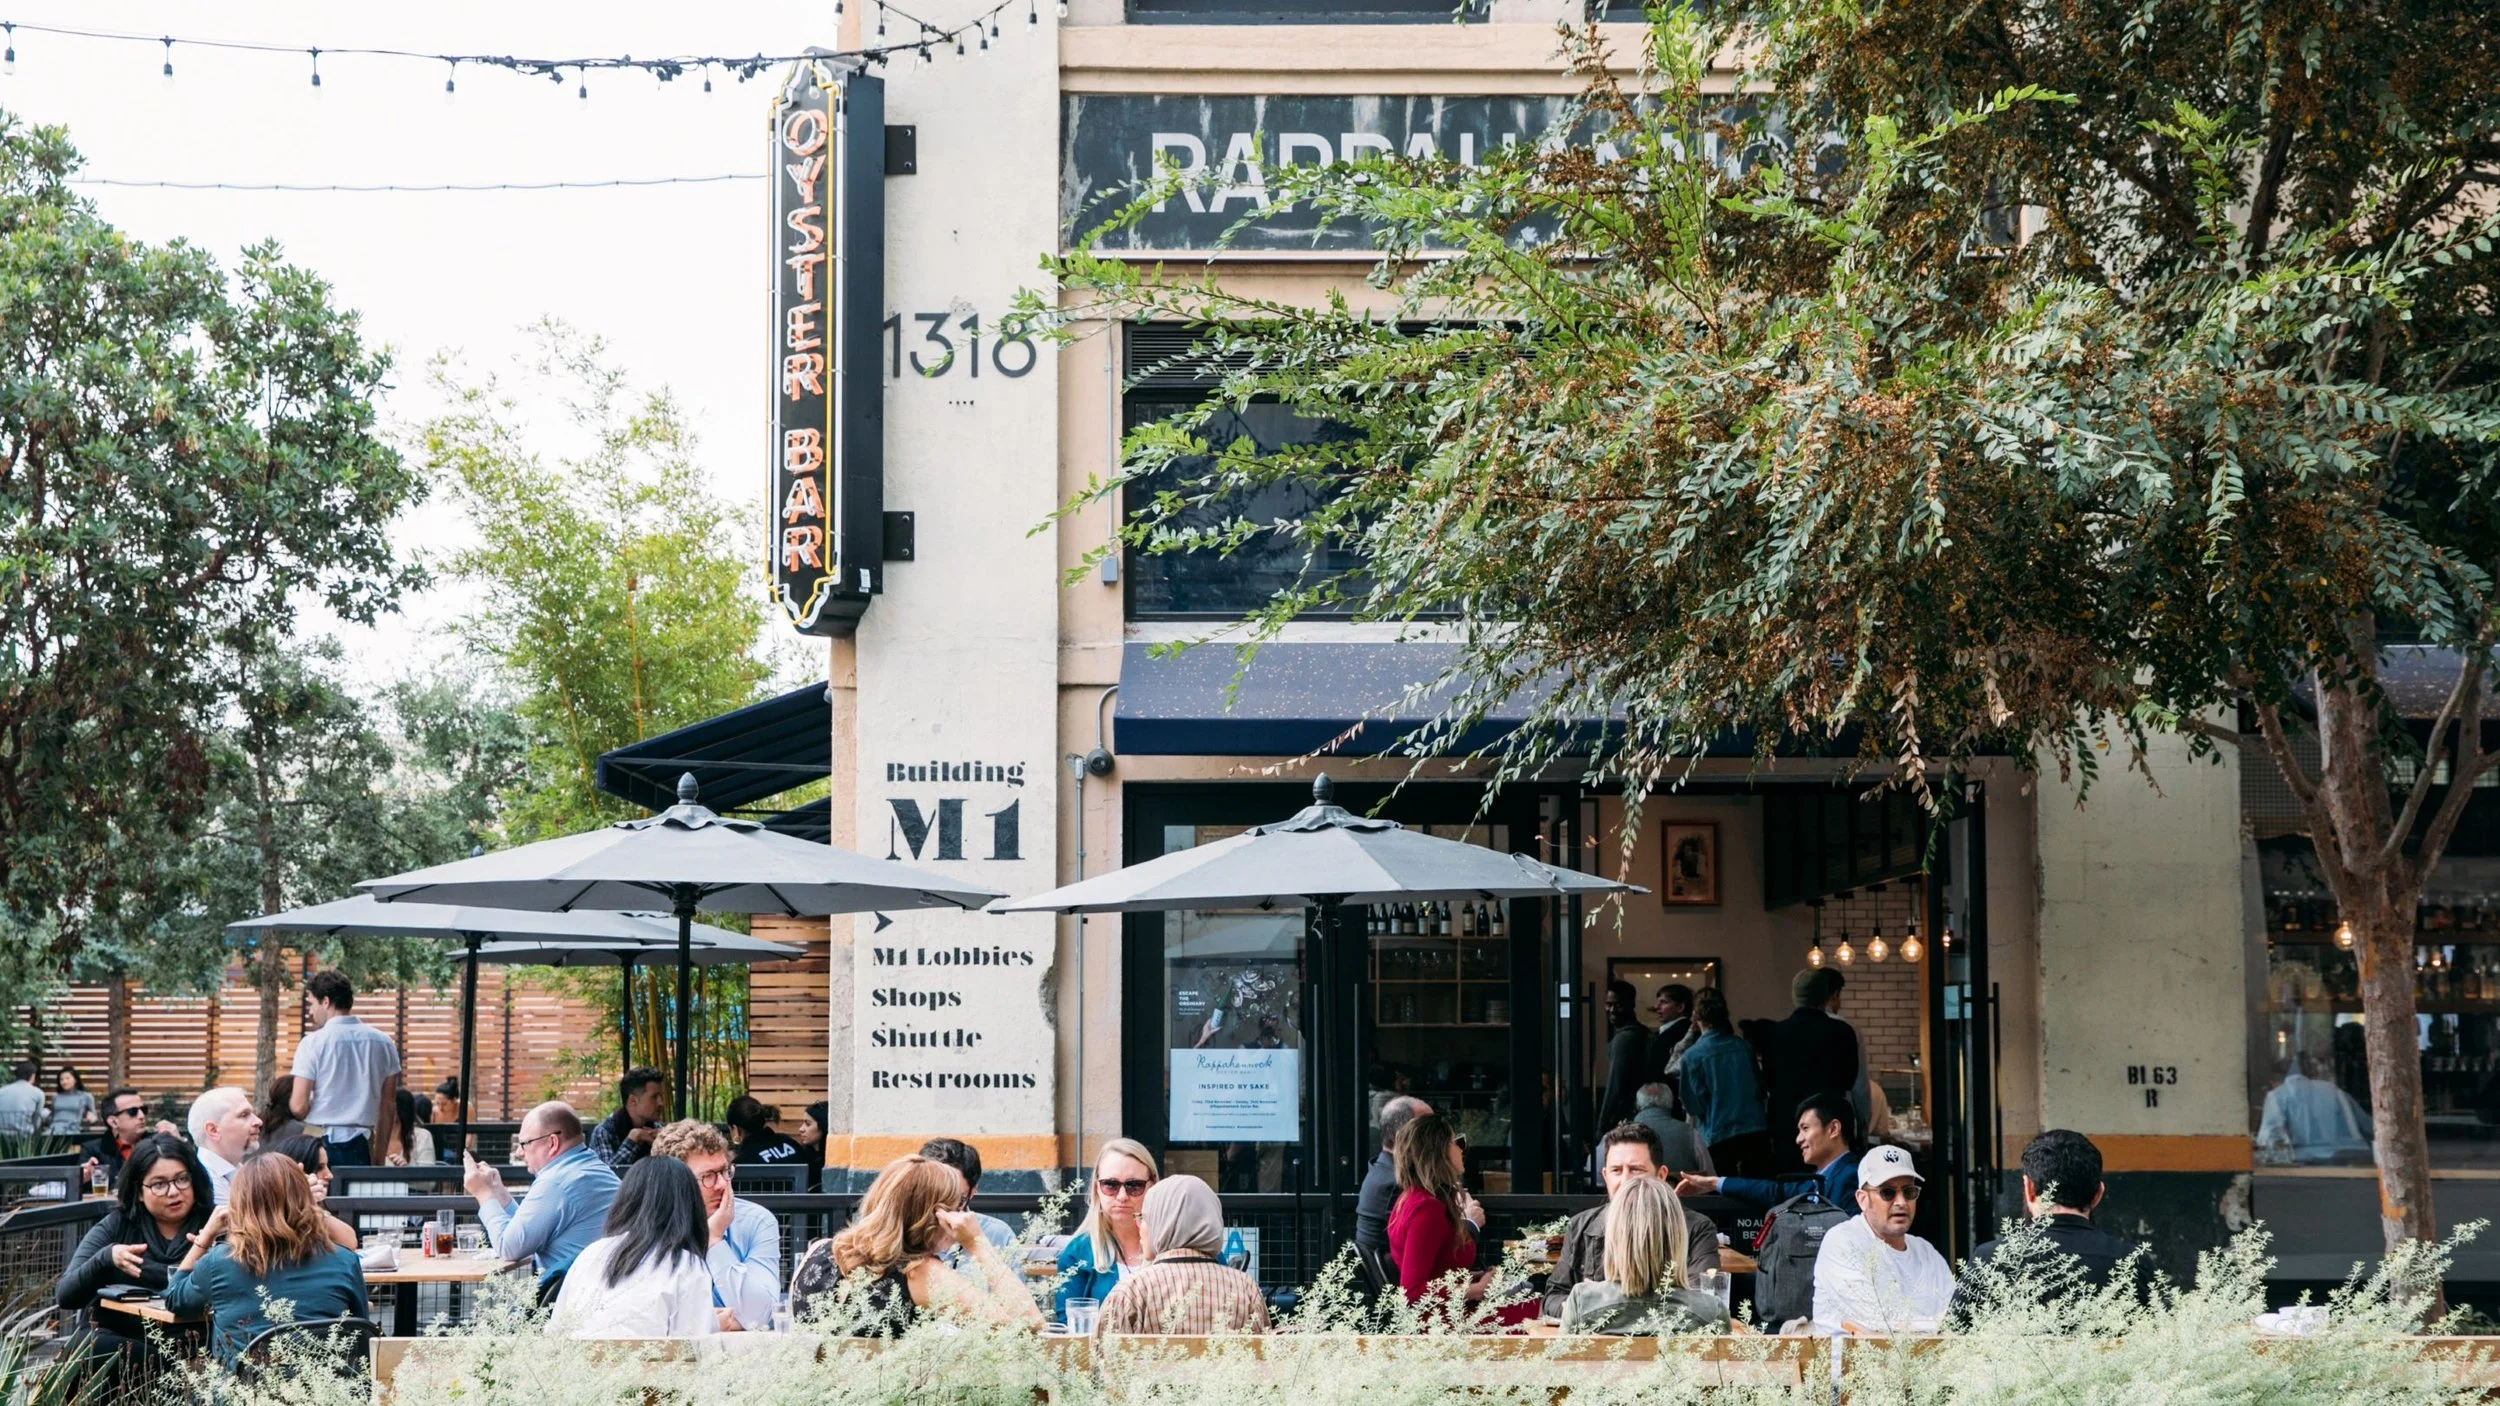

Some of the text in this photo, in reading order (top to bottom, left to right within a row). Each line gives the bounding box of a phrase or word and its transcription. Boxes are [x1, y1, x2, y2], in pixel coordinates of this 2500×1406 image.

[781, 109, 829, 573] OYSTER BAR
[883, 313, 1036, 378] 1318
[886, 760, 1026, 788] Building
[886, 798, 1026, 861] M1
[917, 946, 1034, 966] Lobbies
[872, 987, 962, 1011] Shops
[871, 1028, 983, 1048] Shuttle
[872, 1070, 1037, 1089] Restrooms
[2153, 1066, 2178, 1085] 63
[759, 1143, 796, 1163] FILA
[1737, 1219, 1752, 1228] NO
